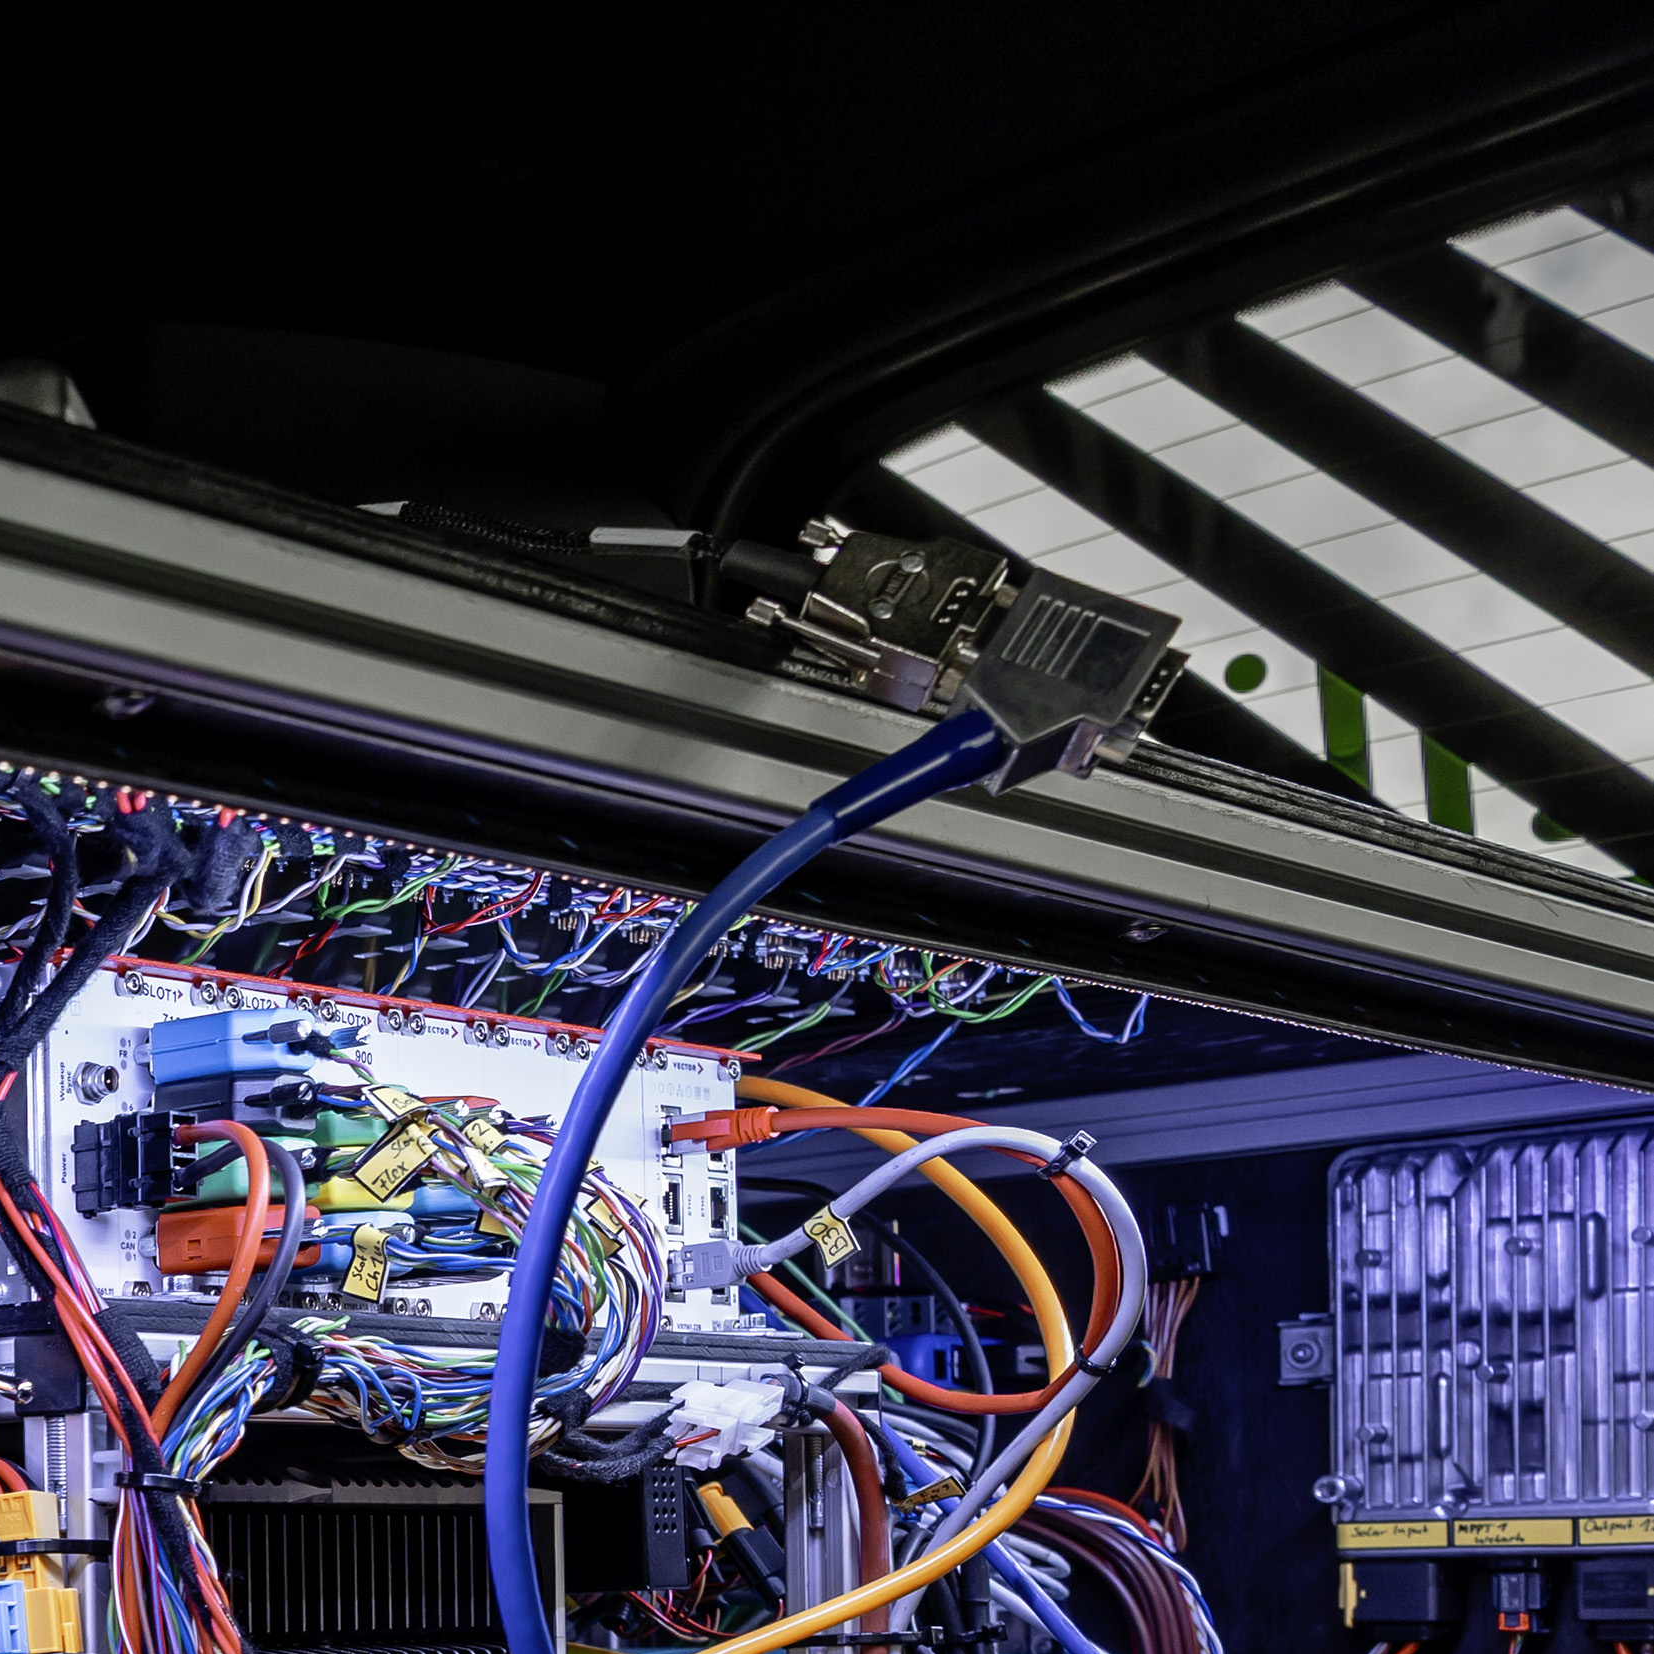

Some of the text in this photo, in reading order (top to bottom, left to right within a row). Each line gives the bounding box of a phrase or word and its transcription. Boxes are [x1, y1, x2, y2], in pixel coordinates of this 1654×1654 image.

[143, 984, 178, 1002] SLOT1
[335, 1010, 367, 1026] SLOT3
[427, 1025, 450, 1037] ECTOR
[511, 1037, 533, 1048] ECTOR
[355, 1049, 373, 1065] 900
[672, 1062, 697, 1073] VECTOR
[120, 1242, 136, 1250] CAN
